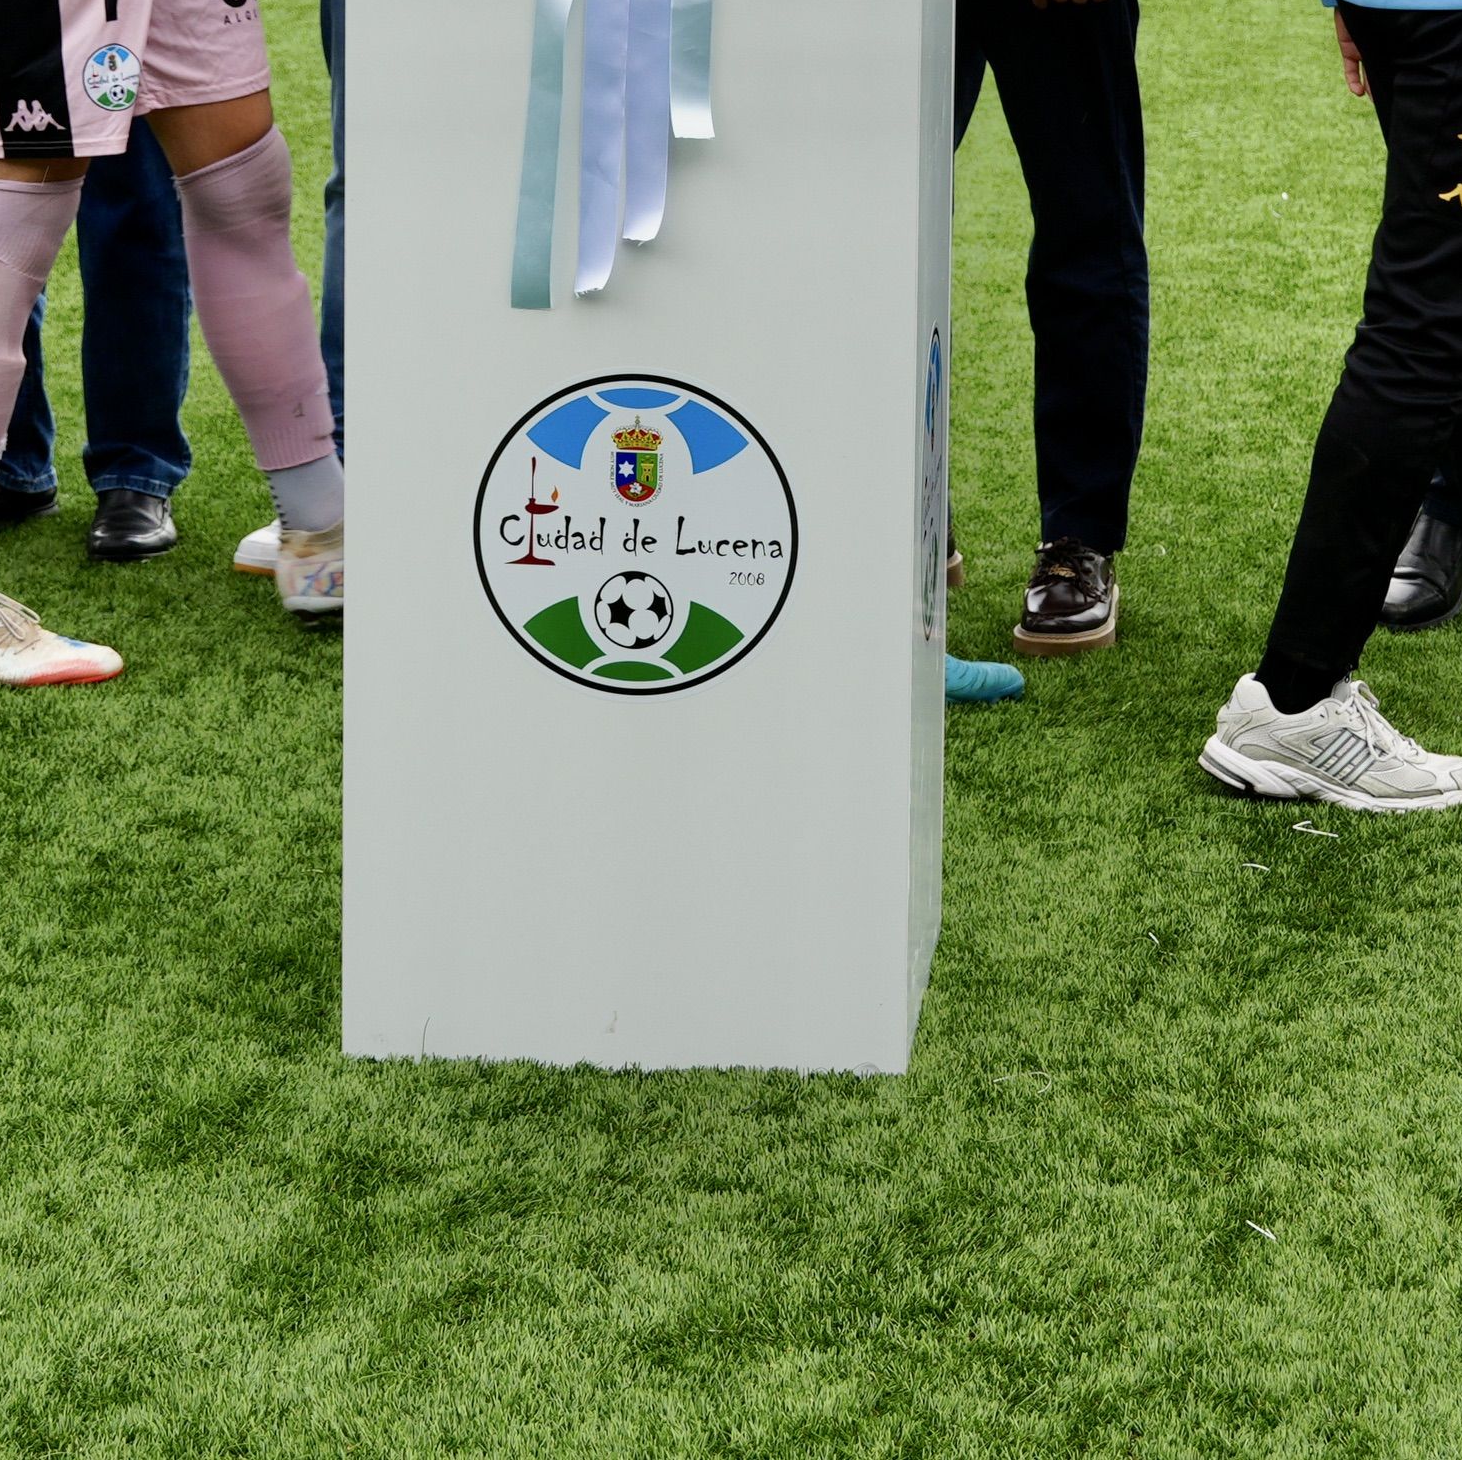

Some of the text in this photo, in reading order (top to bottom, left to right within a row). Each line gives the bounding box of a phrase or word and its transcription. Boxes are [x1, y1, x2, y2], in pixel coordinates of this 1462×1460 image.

[622, 518, 658, 557] de
[675, 515, 785, 559] Lucena
[728, 571, 766, 586] 2008
